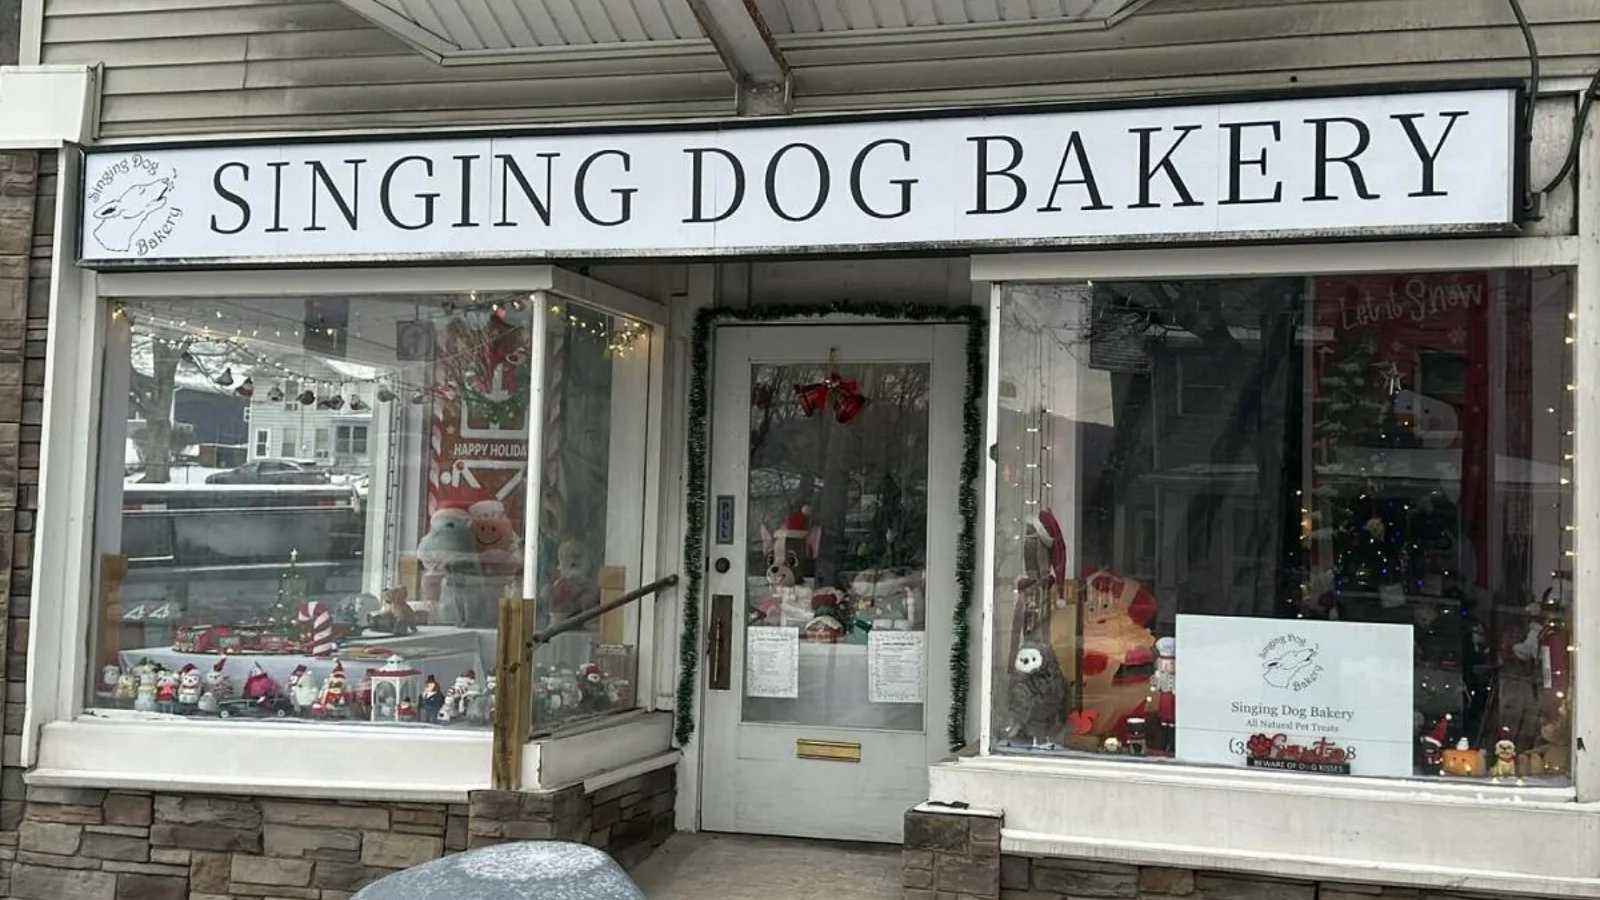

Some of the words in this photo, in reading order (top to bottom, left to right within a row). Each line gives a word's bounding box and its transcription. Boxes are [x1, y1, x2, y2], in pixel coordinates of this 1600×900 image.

[88, 158, 130, 203] Singing
[131, 153, 160, 176] Dog
[210, 149, 638, 235] SINGING
[682, 138, 919, 223] DOG
[965, 110, 1469, 215] BAKERY
[136, 206, 183, 256] Bakery
[1405, 278, 1483, 321] Snow
[453, 442, 489, 457] HAPPY
[1292, 665, 1324, 691] Bakery
[1230, 701, 1279, 718] Singing
[1281, 704, 1308, 720] Dog
[1310, 706, 1355, 722] Bakery
[1246, 719, 1259, 728] All
[1260, 719, 1293, 730] Natural
[1295, 721, 1309, 731] Pet
[1310, 723, 1339, 732] Treats
[1254, 760, 1285, 768] BEWARE
[1286, 761, 1296, 770] OF
[1319, 764, 1344, 773] KISSES
